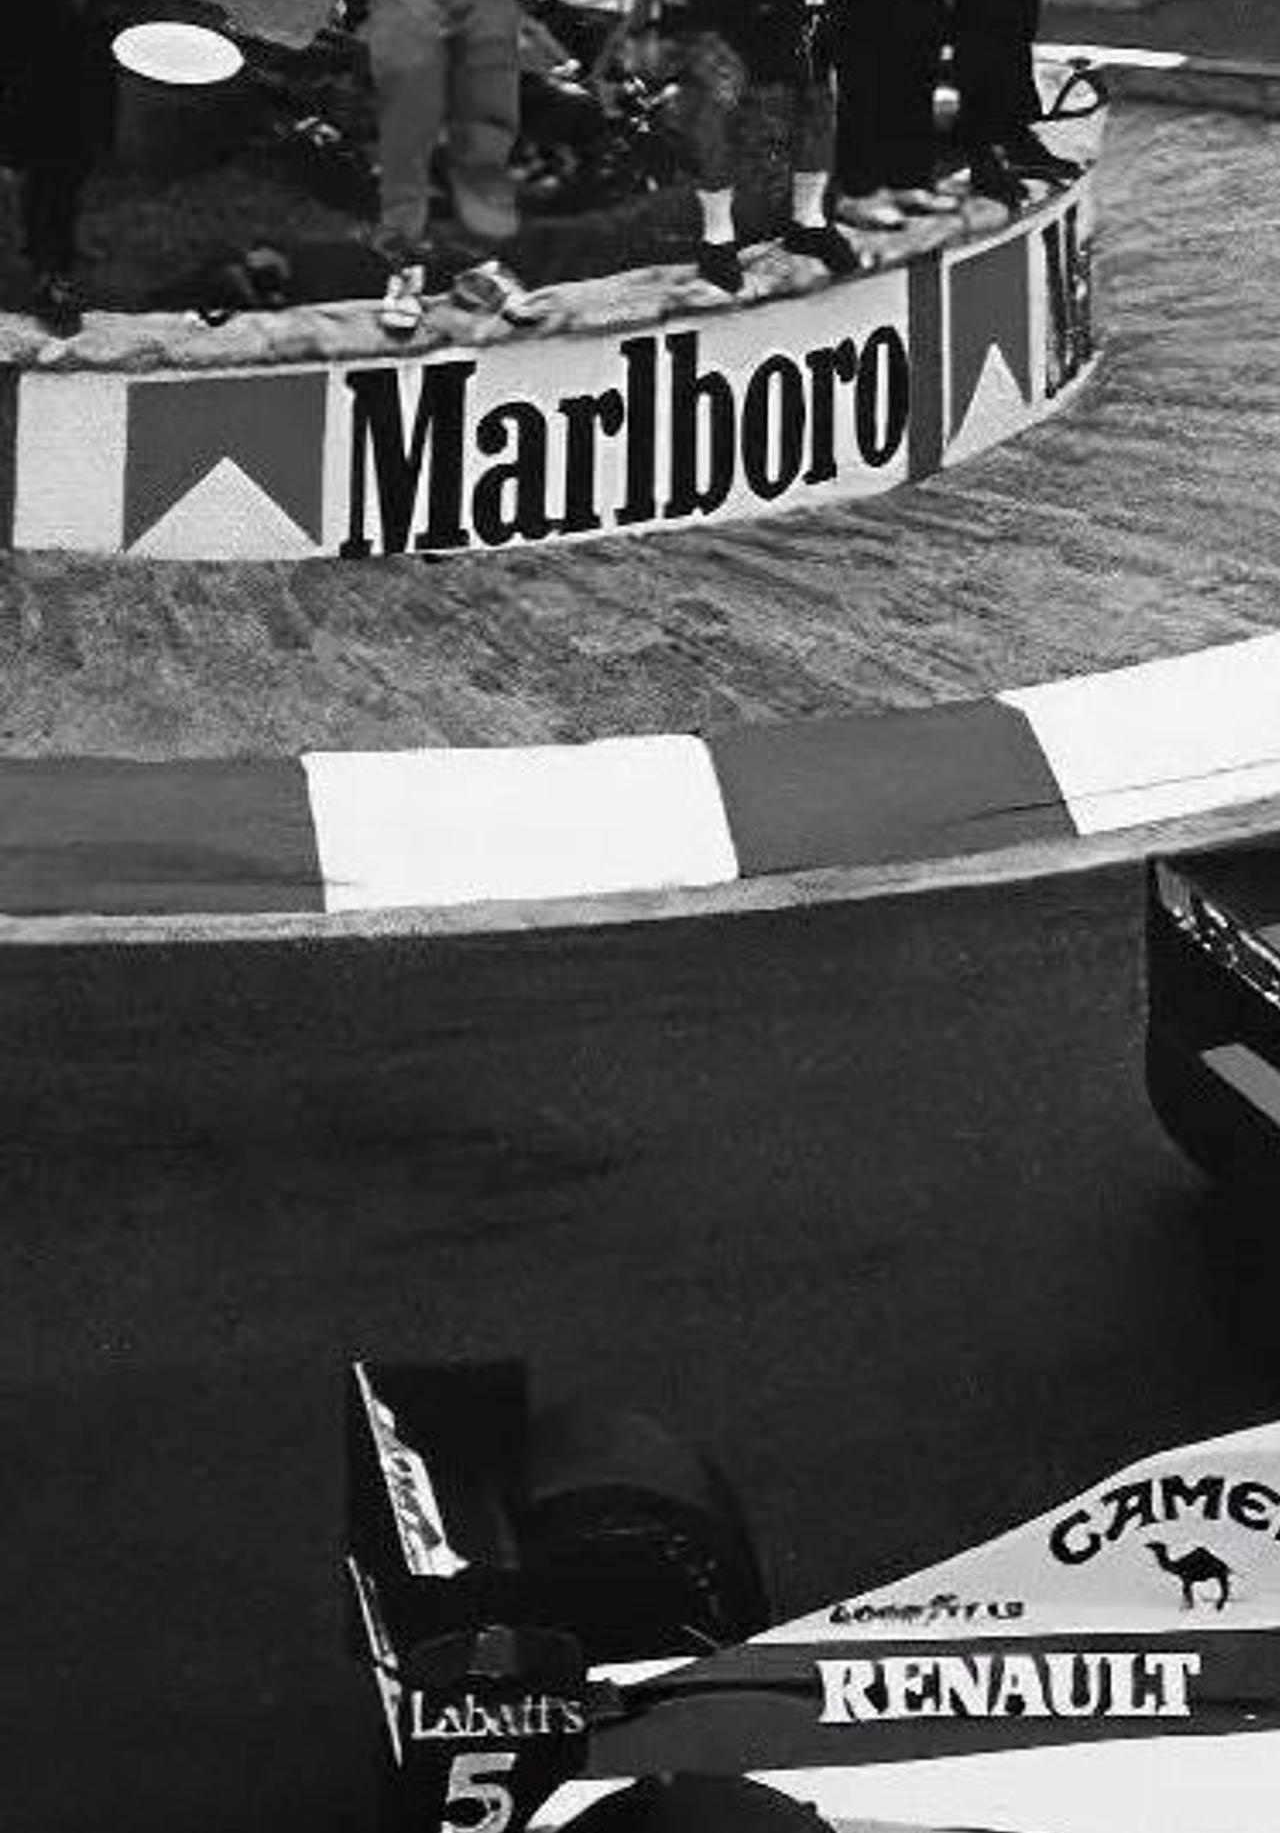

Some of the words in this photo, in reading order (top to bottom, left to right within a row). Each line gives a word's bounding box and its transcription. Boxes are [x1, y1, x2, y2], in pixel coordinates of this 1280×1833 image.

[337, 324, 909, 560] Marlboro
[411, 1691, 585, 1740] Labatt's
[817, 1653, 1201, 1722] RENAULT
